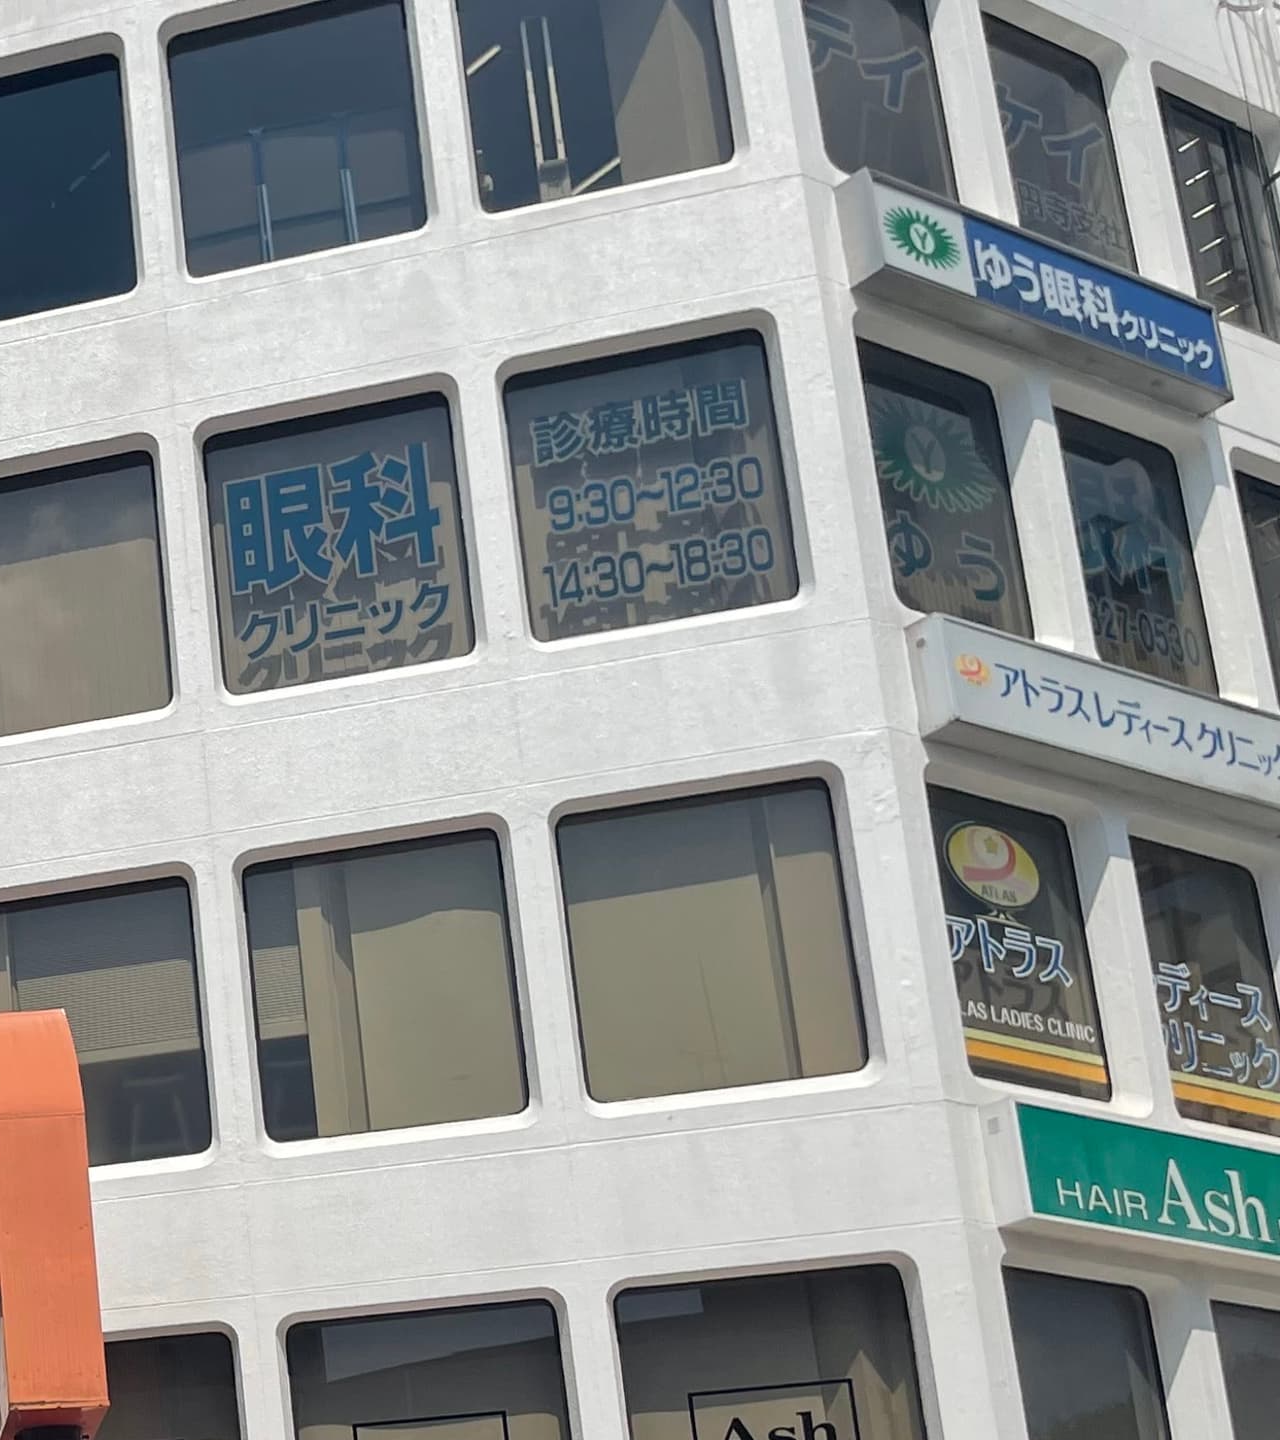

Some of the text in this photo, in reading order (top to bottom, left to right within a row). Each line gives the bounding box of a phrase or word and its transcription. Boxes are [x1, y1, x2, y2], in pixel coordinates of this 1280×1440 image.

[973, 239, 1215, 371] ゆう眼科クリニック
[529, 380, 750, 468] 診療時間
[221, 441, 442, 596] 眼科
[239, 580, 451, 662] クリニック
[990, 1004, 1045, 1032] LADIES
[1047, 1017, 1096, 1043] CLINIC
[1161, 1019, 1279, 1089] リニック
[1056, 1157, 1276, 1244] HAIR Ash
